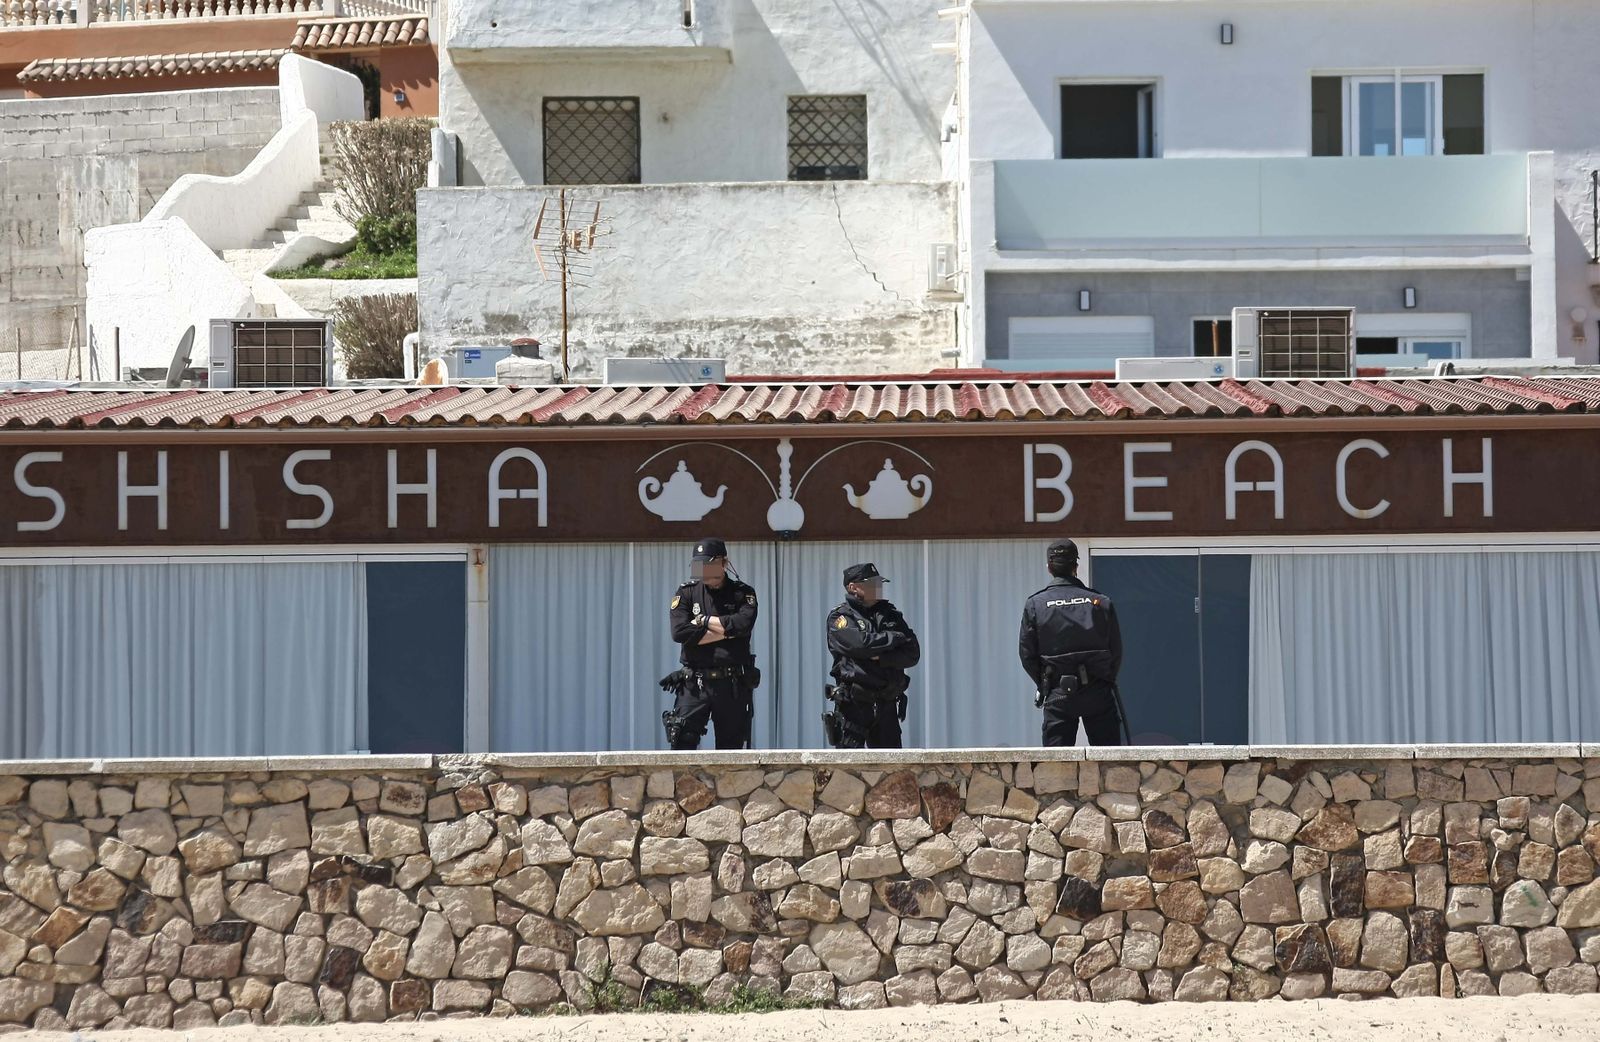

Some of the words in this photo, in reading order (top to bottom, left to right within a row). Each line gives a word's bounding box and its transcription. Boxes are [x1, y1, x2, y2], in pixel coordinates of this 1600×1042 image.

[14, 447, 548, 532] SHISHA
[1024, 437, 1493, 523] BEACH
[1046, 597, 1092, 608] POLICIA
